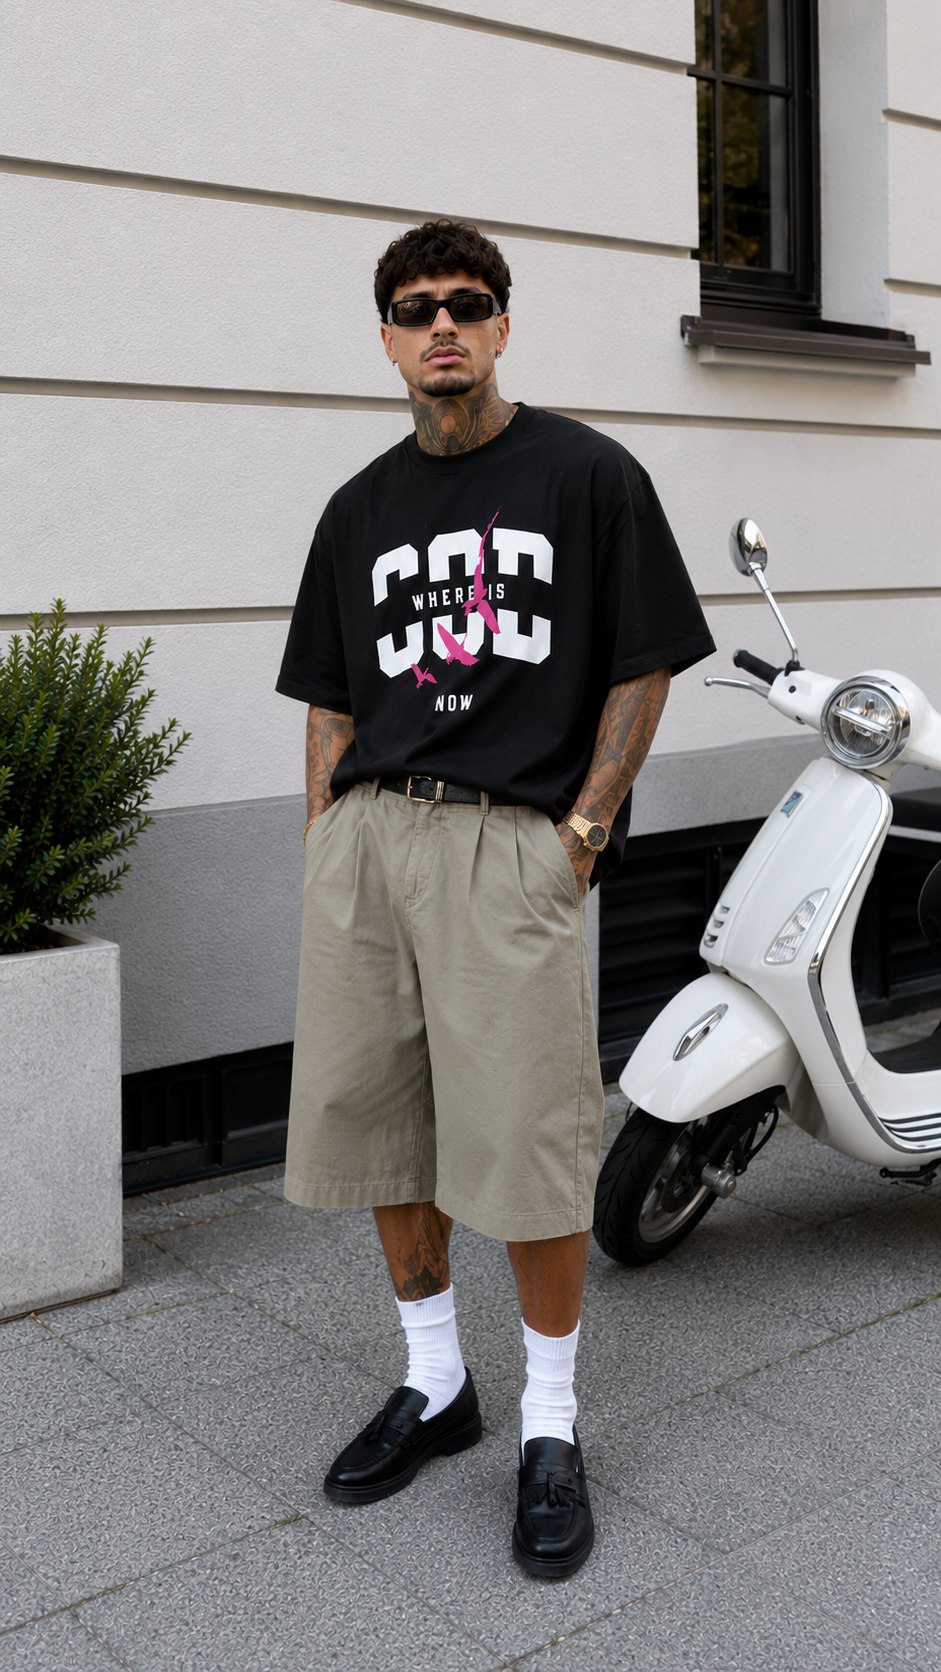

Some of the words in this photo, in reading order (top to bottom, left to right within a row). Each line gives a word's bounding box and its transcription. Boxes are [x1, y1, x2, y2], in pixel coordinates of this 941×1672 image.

[411, 585, 476, 612] WHERE
[488, 583, 506, 601] IS
[434, 694, 474, 712] NOW
